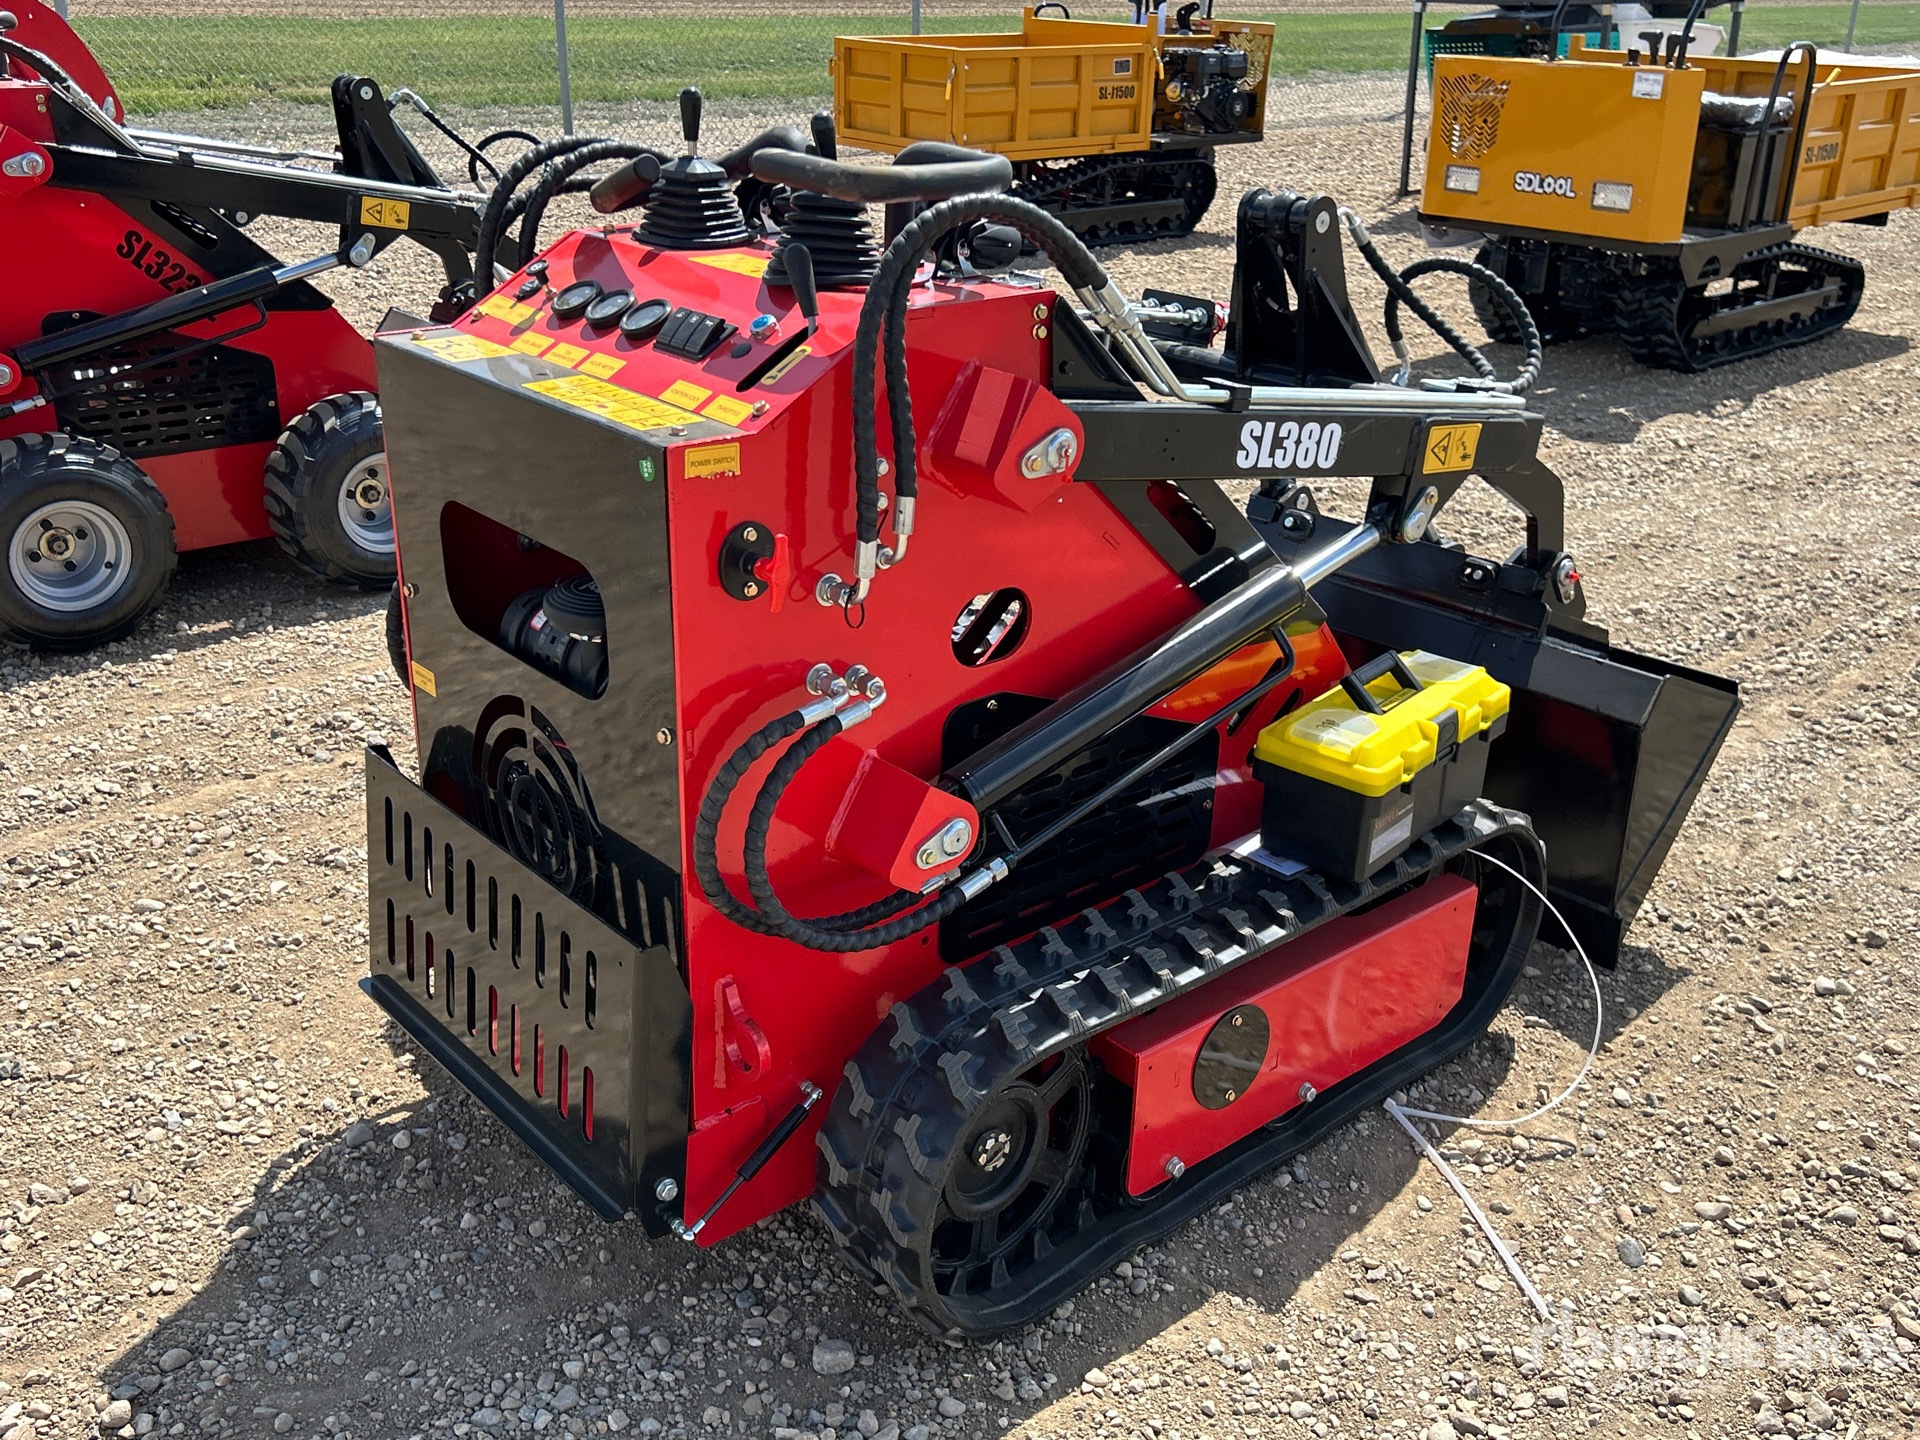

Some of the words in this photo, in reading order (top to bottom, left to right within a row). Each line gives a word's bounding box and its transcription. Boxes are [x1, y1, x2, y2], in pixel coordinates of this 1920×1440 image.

[1099, 85, 1136, 100] SL-J1500
[717, 404, 742, 417] THROTTLE
[1236, 420, 1343, 470] SL380
[690, 460, 711, 468] POWER
[712, 456, 735, 465] SWITCH
